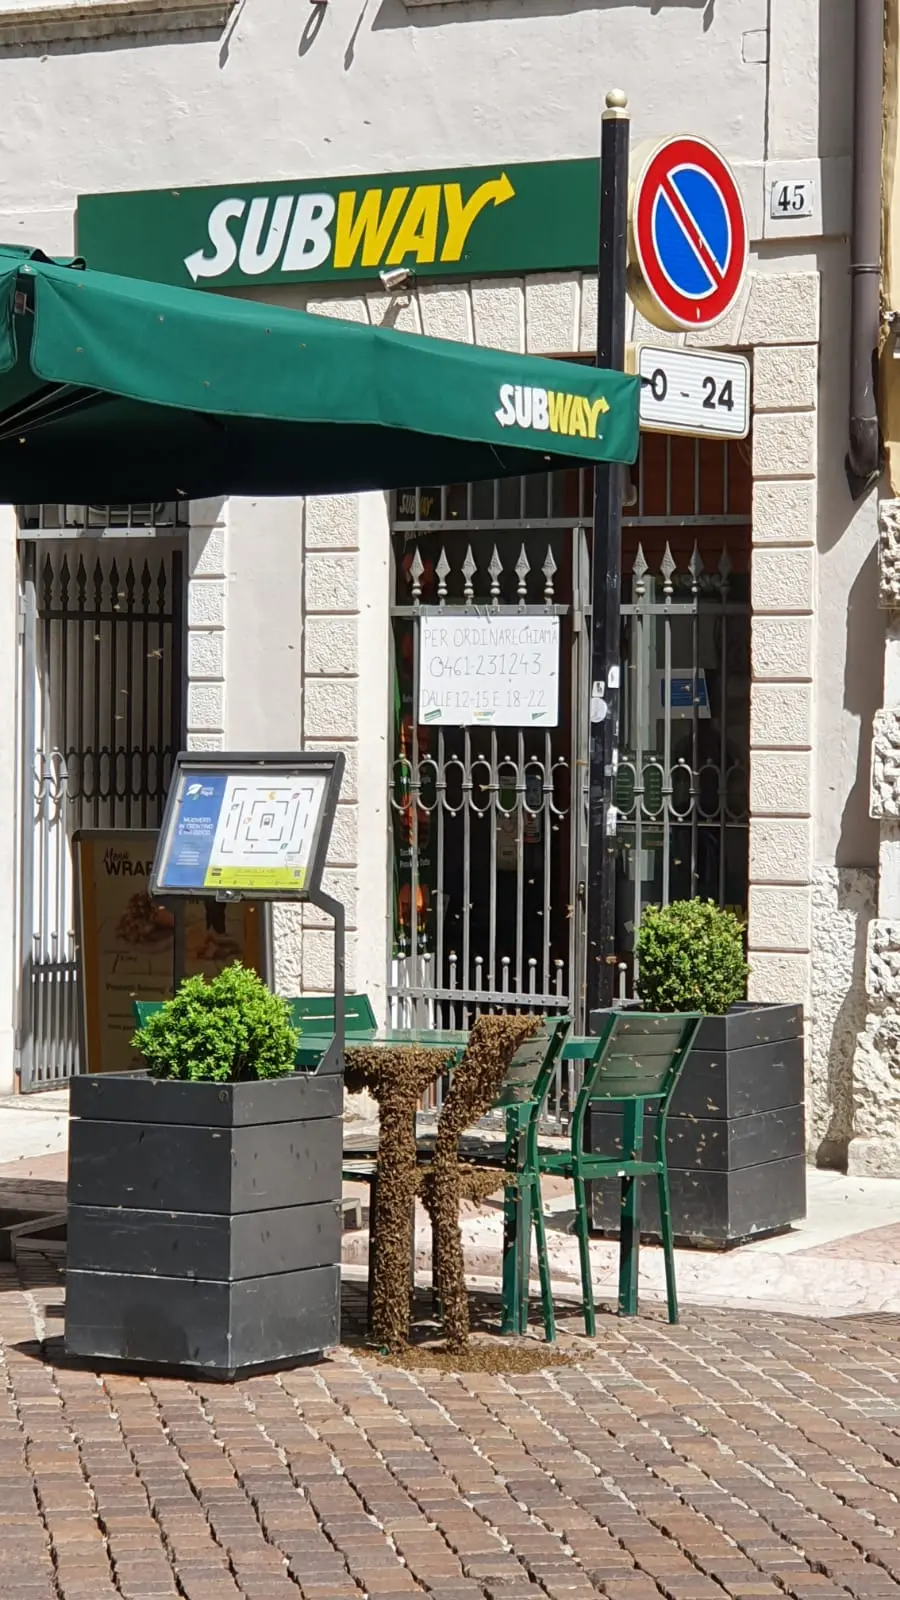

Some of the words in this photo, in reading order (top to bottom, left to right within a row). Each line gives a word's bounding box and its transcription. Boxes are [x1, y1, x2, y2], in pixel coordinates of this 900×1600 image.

[778, 185, 805, 211] 45
[184, 172, 515, 282] SUBWAY
[651, 368, 667, 401] 0
[702, 376, 734, 411] 24
[495, 384, 610, 438] SUBWAY
[424, 628, 449, 648] PER
[453, 628, 519, 648] ORDINARE
[519, 628, 557, 646] CHIAMA
[493, 691, 501, 707] E
[507, 690, 547, 708] 18-22
